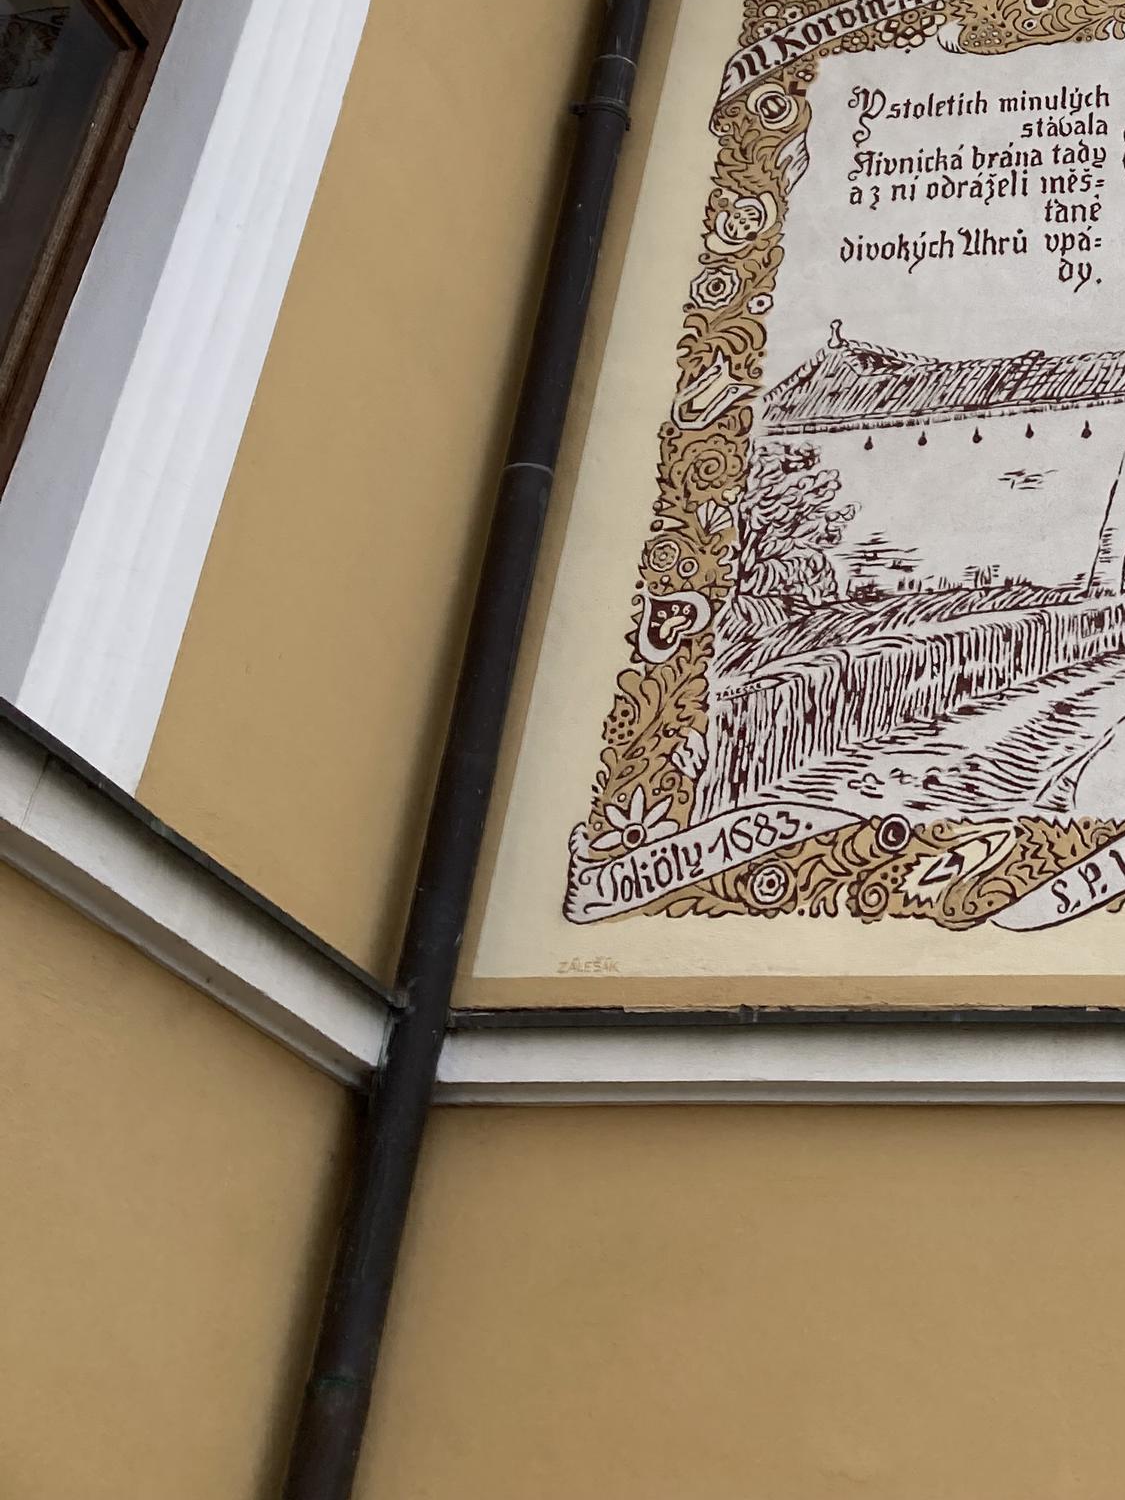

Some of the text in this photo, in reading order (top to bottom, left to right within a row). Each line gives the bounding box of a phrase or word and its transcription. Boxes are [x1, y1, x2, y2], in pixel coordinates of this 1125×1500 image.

[998, 84, 1111, 116] minulých
[971, 141, 1044, 171] brána
[1052, 139, 1107, 169] tady
[849, 186, 863, 205] a
[891, 175, 919, 202] ní
[839, 229, 955, 275] divokých
